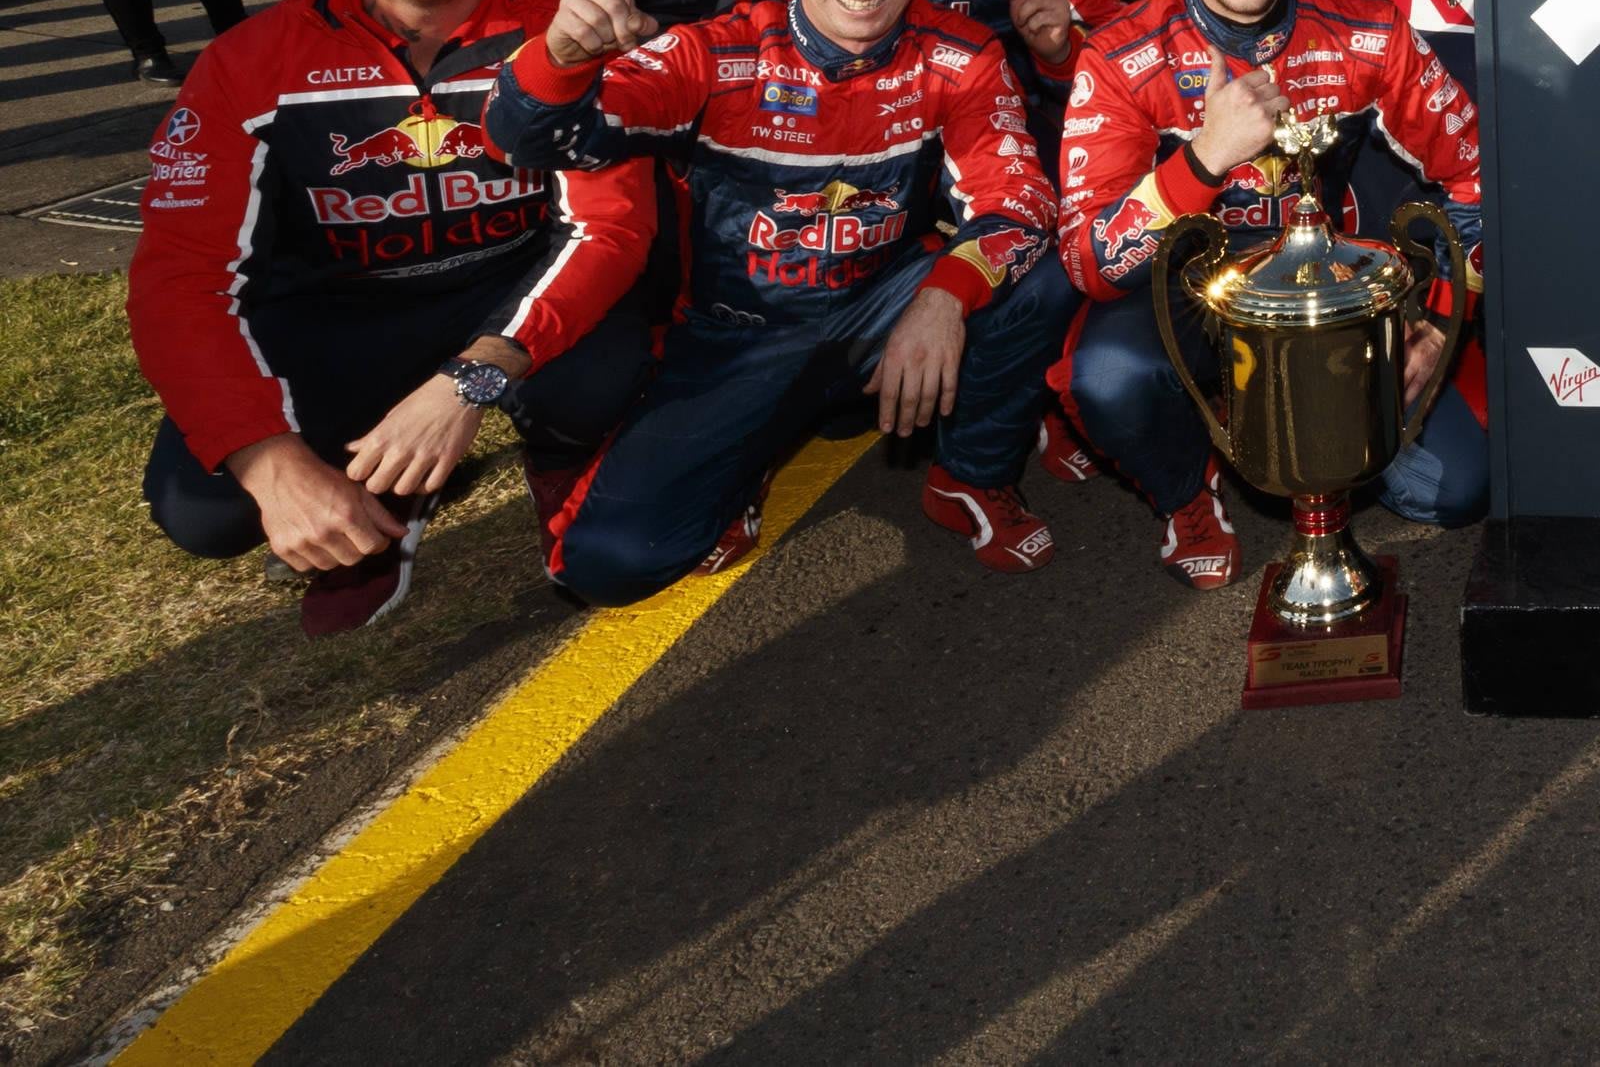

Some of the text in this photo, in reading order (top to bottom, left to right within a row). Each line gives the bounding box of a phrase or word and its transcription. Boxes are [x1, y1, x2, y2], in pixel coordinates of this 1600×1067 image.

[1350, 35, 1387, 51] OMP
[932, 47, 970, 68] OMP
[1122, 47, 1160, 76] OMP
[1182, 52, 1212, 66] CAL
[307, 65, 384, 84] CALTEX
[718, 62, 755, 79] OMP
[752, 126, 814, 144] TW STEEL
[306, 168, 545, 223] Red Bull
[748, 210, 908, 254] Red Bull
